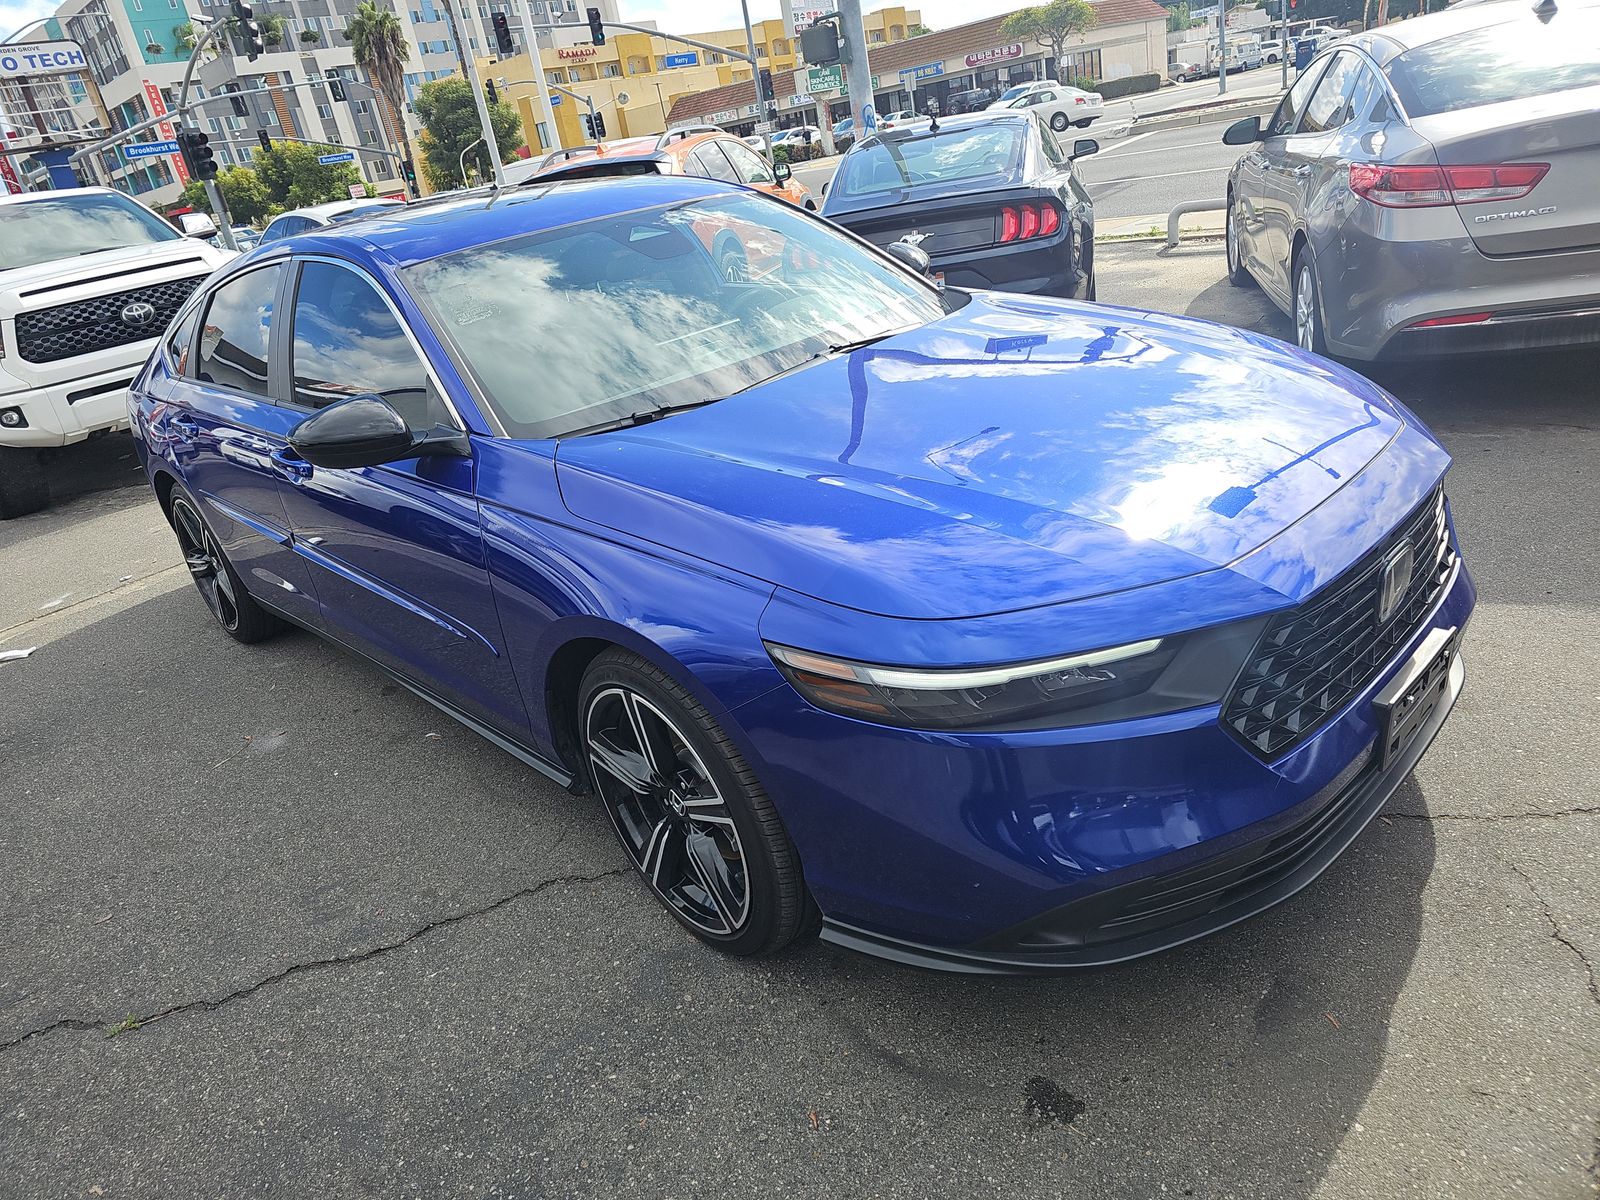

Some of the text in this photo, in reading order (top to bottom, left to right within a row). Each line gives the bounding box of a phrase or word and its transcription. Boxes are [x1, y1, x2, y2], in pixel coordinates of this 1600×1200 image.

[23, 50, 84, 68] TECH
[558, 48, 597, 59] RAMADA
[811, 81, 840, 90] COSMETICS
[130, 144, 168, 155] Brookhurst
[1474, 209, 1537, 223] OPTIMA
